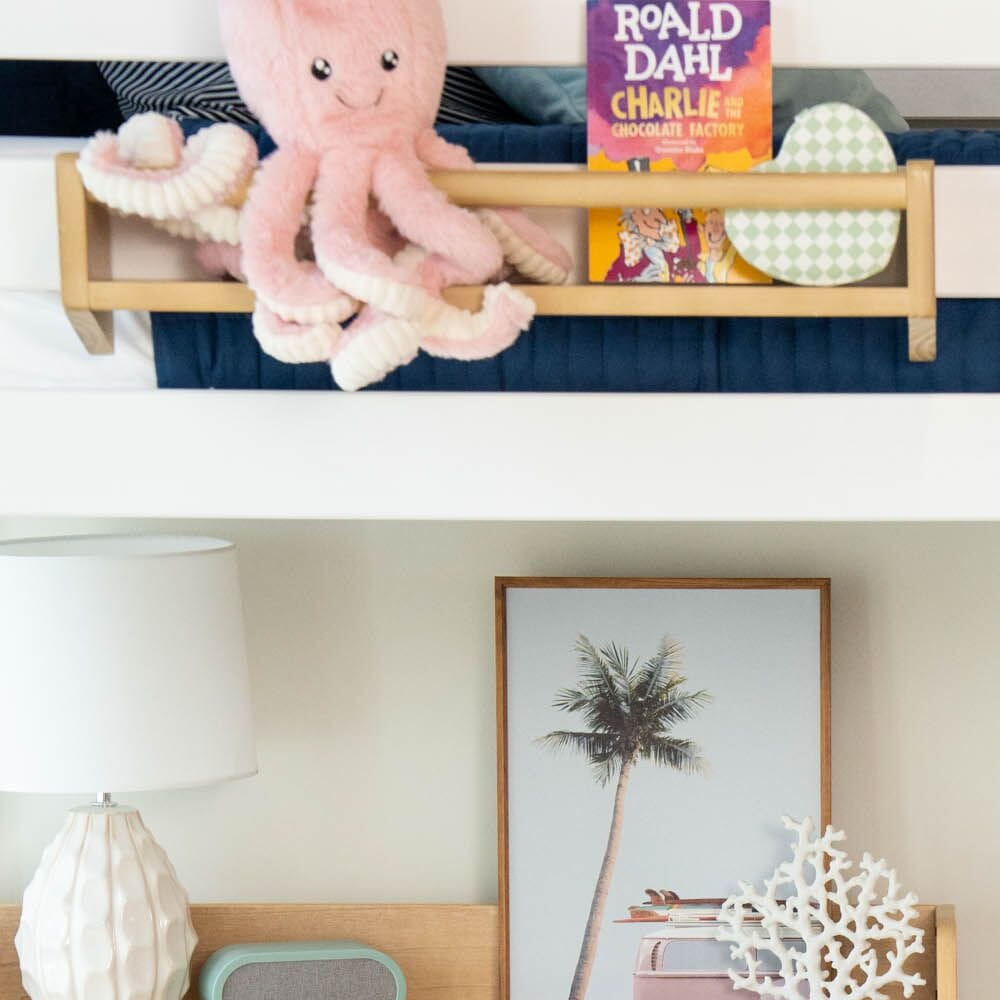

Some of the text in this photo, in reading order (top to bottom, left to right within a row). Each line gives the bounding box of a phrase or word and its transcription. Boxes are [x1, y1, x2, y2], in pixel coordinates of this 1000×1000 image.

[614, 1, 743, 42] ROALD
[624, 43, 732, 82] DAHL
[611, 85, 744, 120] CHARLIE AND
[726, 107, 742, 119] THE
[611, 122, 744, 137] CHOCOLATE FACTORY
